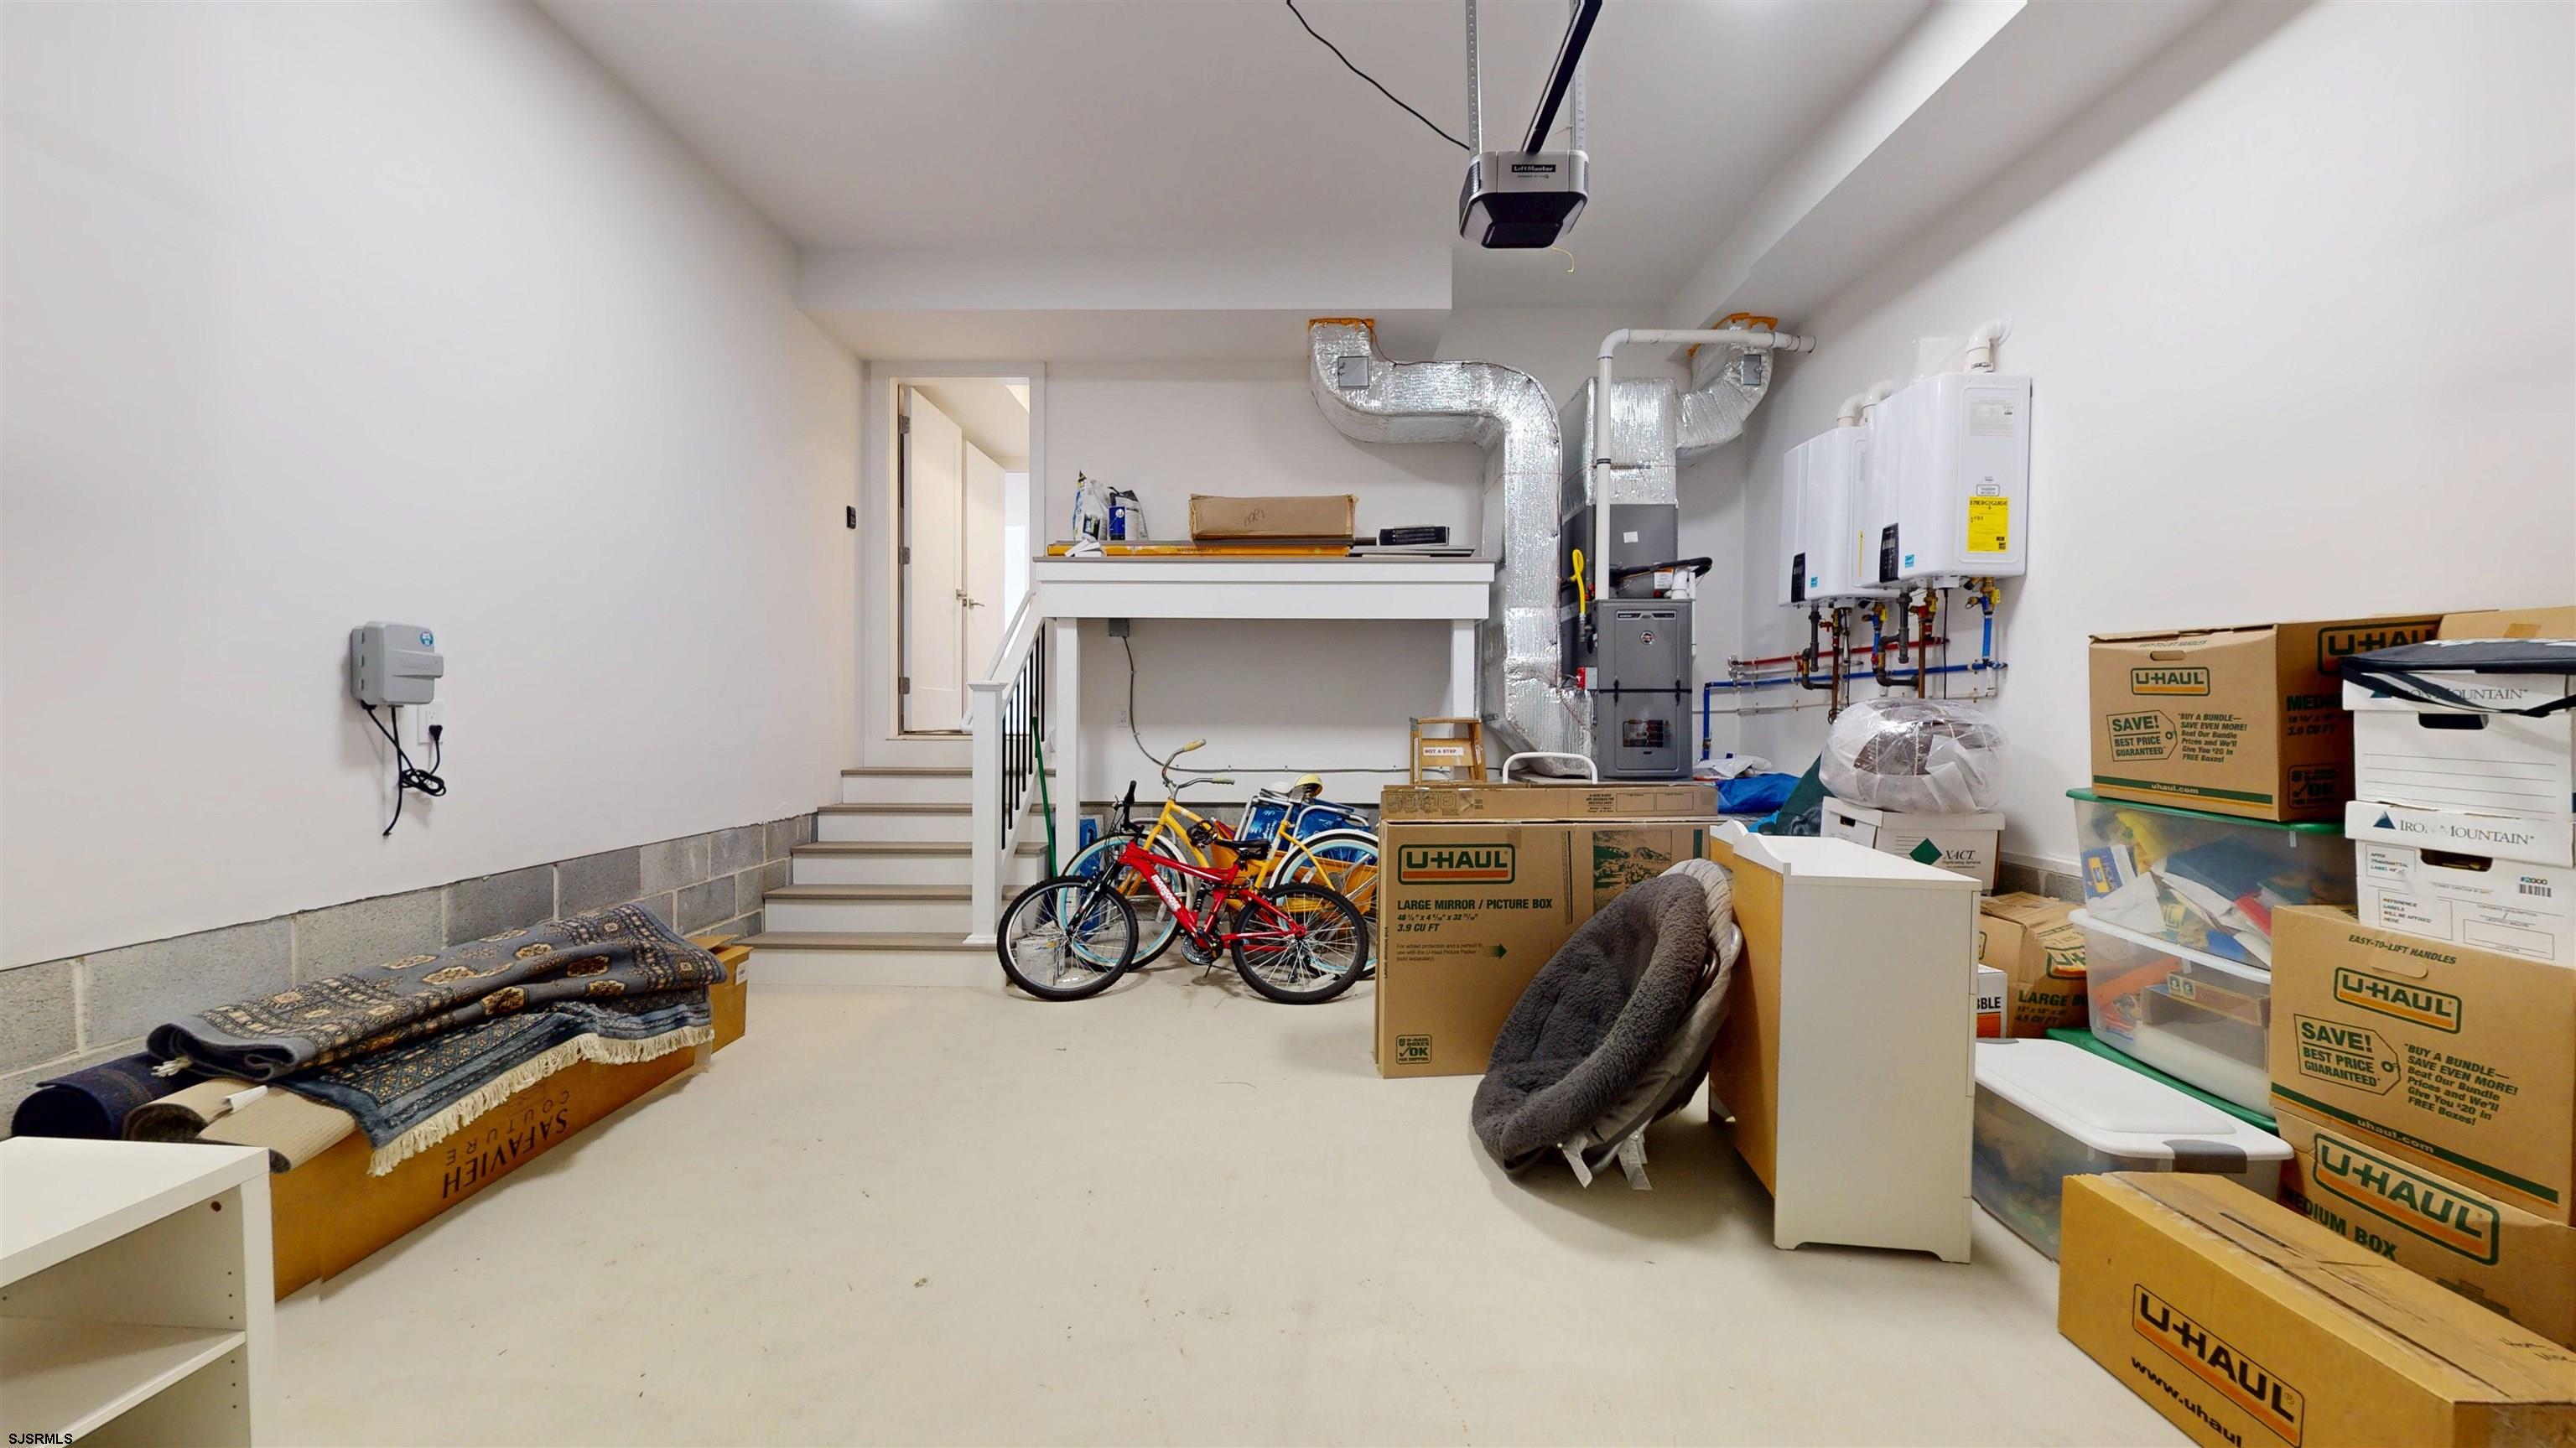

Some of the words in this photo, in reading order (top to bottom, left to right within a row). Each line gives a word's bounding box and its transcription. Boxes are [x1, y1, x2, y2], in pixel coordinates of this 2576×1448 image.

[2135, 672, 2205, 685] U-HAUL
[2448, 688, 2523, 700] OUNTAIN
[2112, 715, 2159, 732] SAVE!
[2114, 738, 2137, 747] BEST
[2137, 736, 2161, 745] PRICE
[2151, 783, 2199, 794] uhaul.com
[2400, 819, 2429, 834] IRO
[1406, 850, 1509, 869] U-HAUL
[1943, 850, 1976, 860] XACT
[1150, 874, 1182, 912] mongoose
[1397, 900, 1431, 910] LARGE
[1435, 900, 1476, 910] MIRROR
[1478, 900, 1483, 909] /
[1486, 899, 1529, 909] PICTURE
[1532, 898, 1552, 909] BOX
[1397, 923, 1411, 932] 3.9
[1414, 923, 1426, 932] CU
[1428, 923, 1440, 932] FT
[2349, 935, 2408, 953] EASY-TO-LIFT
[2410, 948, 2457, 964] HANDLES
[2018, 990, 2068, 1006] LARGE
[2342, 973, 2451, 1017] U-HAUL
[1410, 1047, 1429, 1056] OK
[2301, 1022, 2372, 1053] SAVE!
[2303, 1046, 2332, 1063] BEST
[2335, 1055, 2375, 1073] PRICE
[2433, 1052, 2442, 1061] A
[2407, 1056, 2437, 1071] SAVE
[2440, 1066, 2471, 1082] EVEN
[2475, 1076, 2519, 1096] MORE!
[2407, 1066, 2432, 1079] Beat
[2435, 1075, 2455, 1087] Our
[2458, 1082, 2501, 1101] Bundle
[2407, 1076, 2441, 1093] Prices
[2444, 1088, 2466, 1101] and
[2470, 1096, 2500, 1112] We'll
[2408, 1087, 2430, 1100] Give
[2435, 1095, 2454, 1108] You
[2480, 1109, 2492, 1121] in
[2408, 1096, 2435, 1112] FREE
[2438, 1107, 2477, 1126] Boxes!
[447, 1090, 569, 1166] COUTURE
[2357, 1118, 2434, 1154] uhaul.com
[443, 1108, 569, 1199] SAFAVIEH
[2321, 1144, 2482, 1239] U-HAUL
[2354, 1226, 2398, 1262] BOX
[2140, 1293, 2294, 1424] U-HAUL
